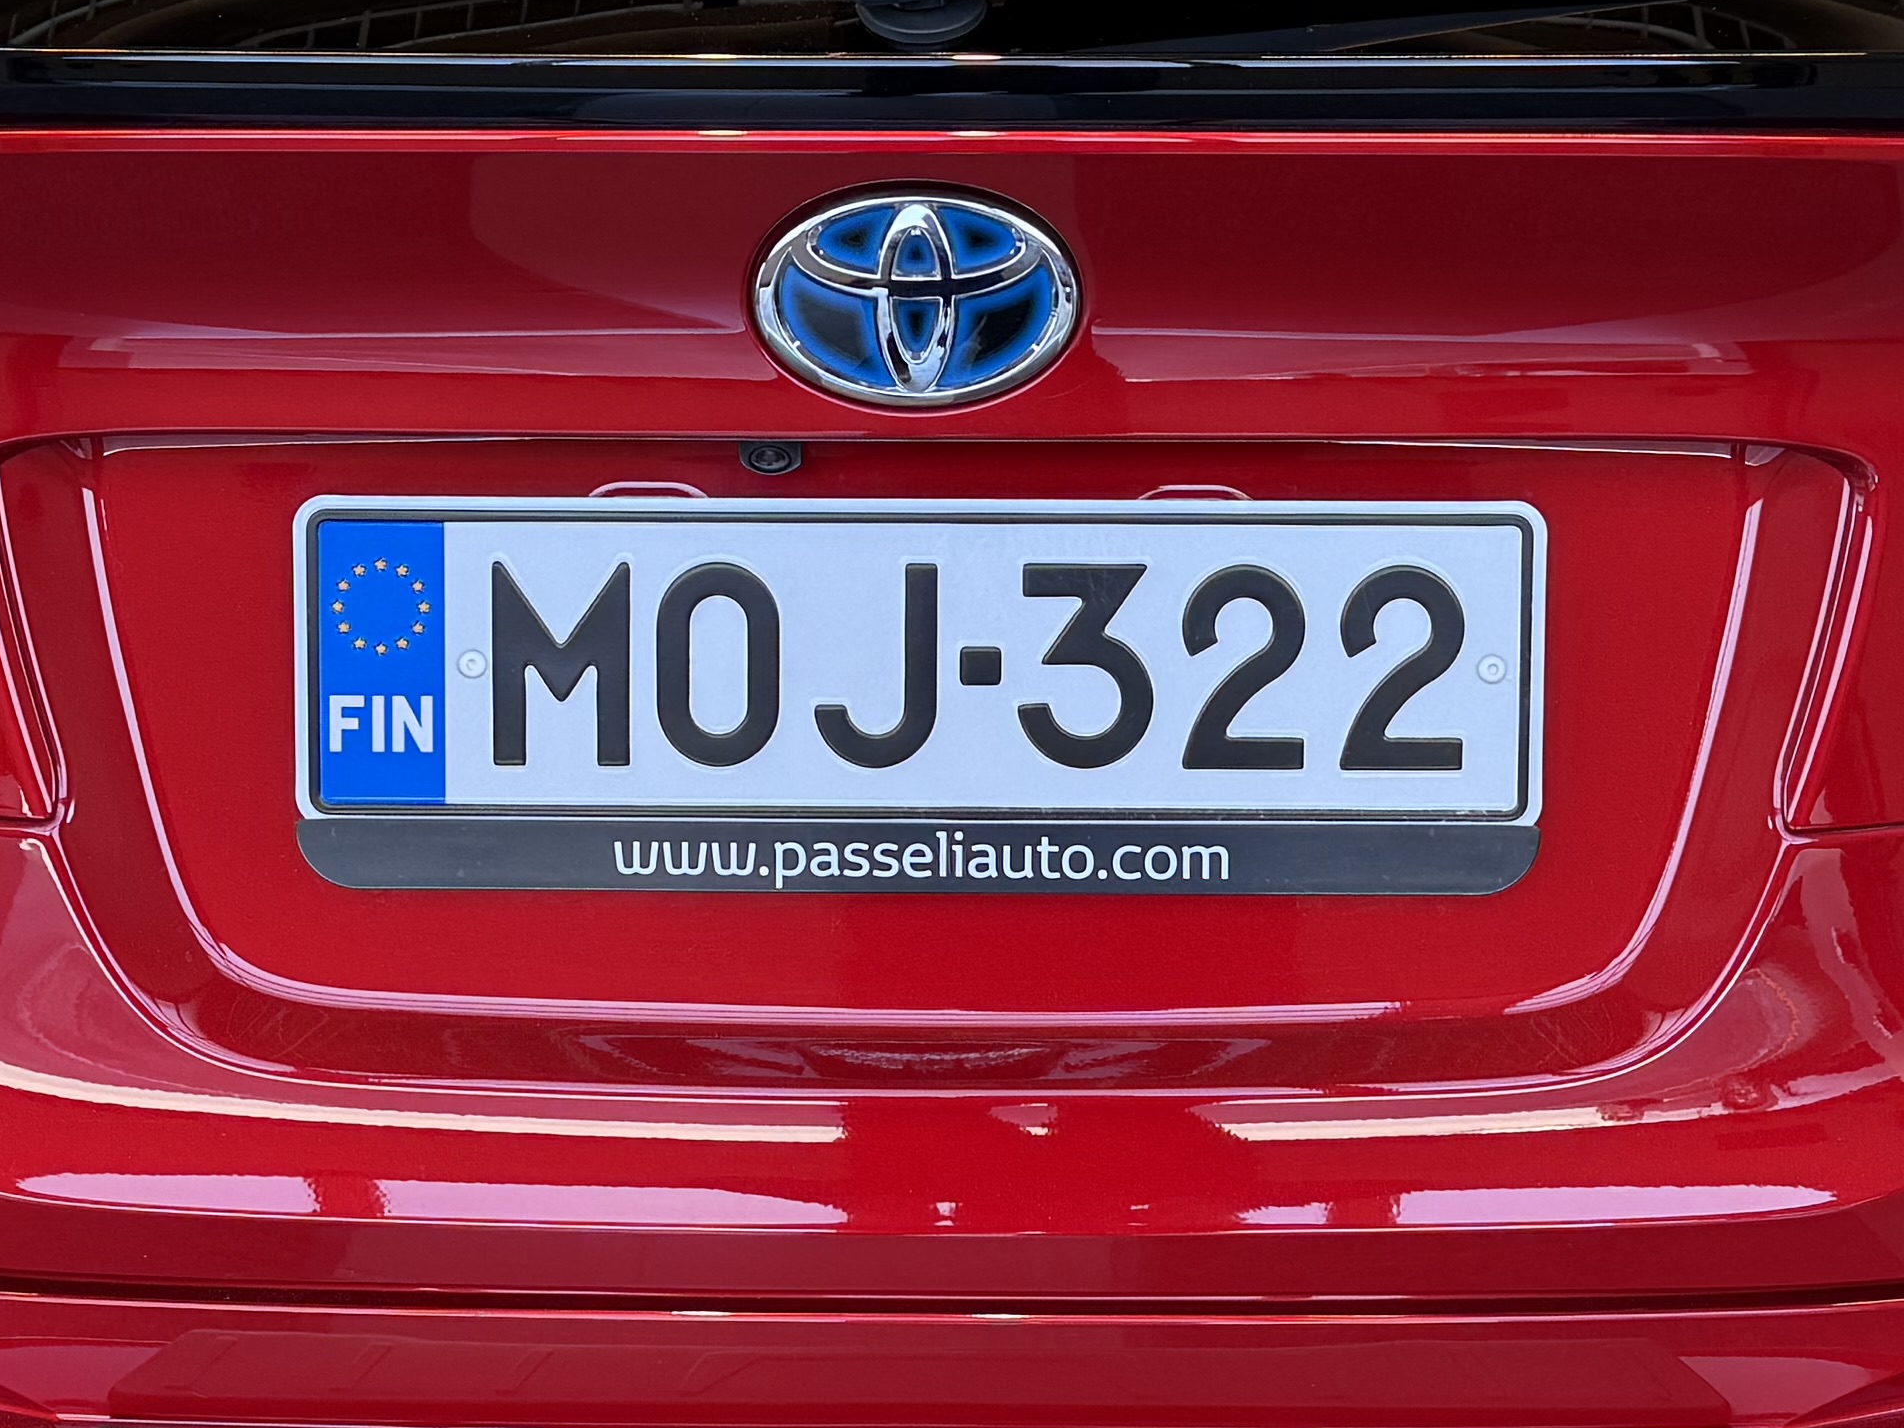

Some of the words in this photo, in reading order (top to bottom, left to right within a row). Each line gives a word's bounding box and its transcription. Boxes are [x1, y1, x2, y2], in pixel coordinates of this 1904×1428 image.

[491, 560, 1467, 769] MOJ-322
[328, 694, 434, 753] FIN
[613, 830, 1230, 890] www.passeliauto.com
